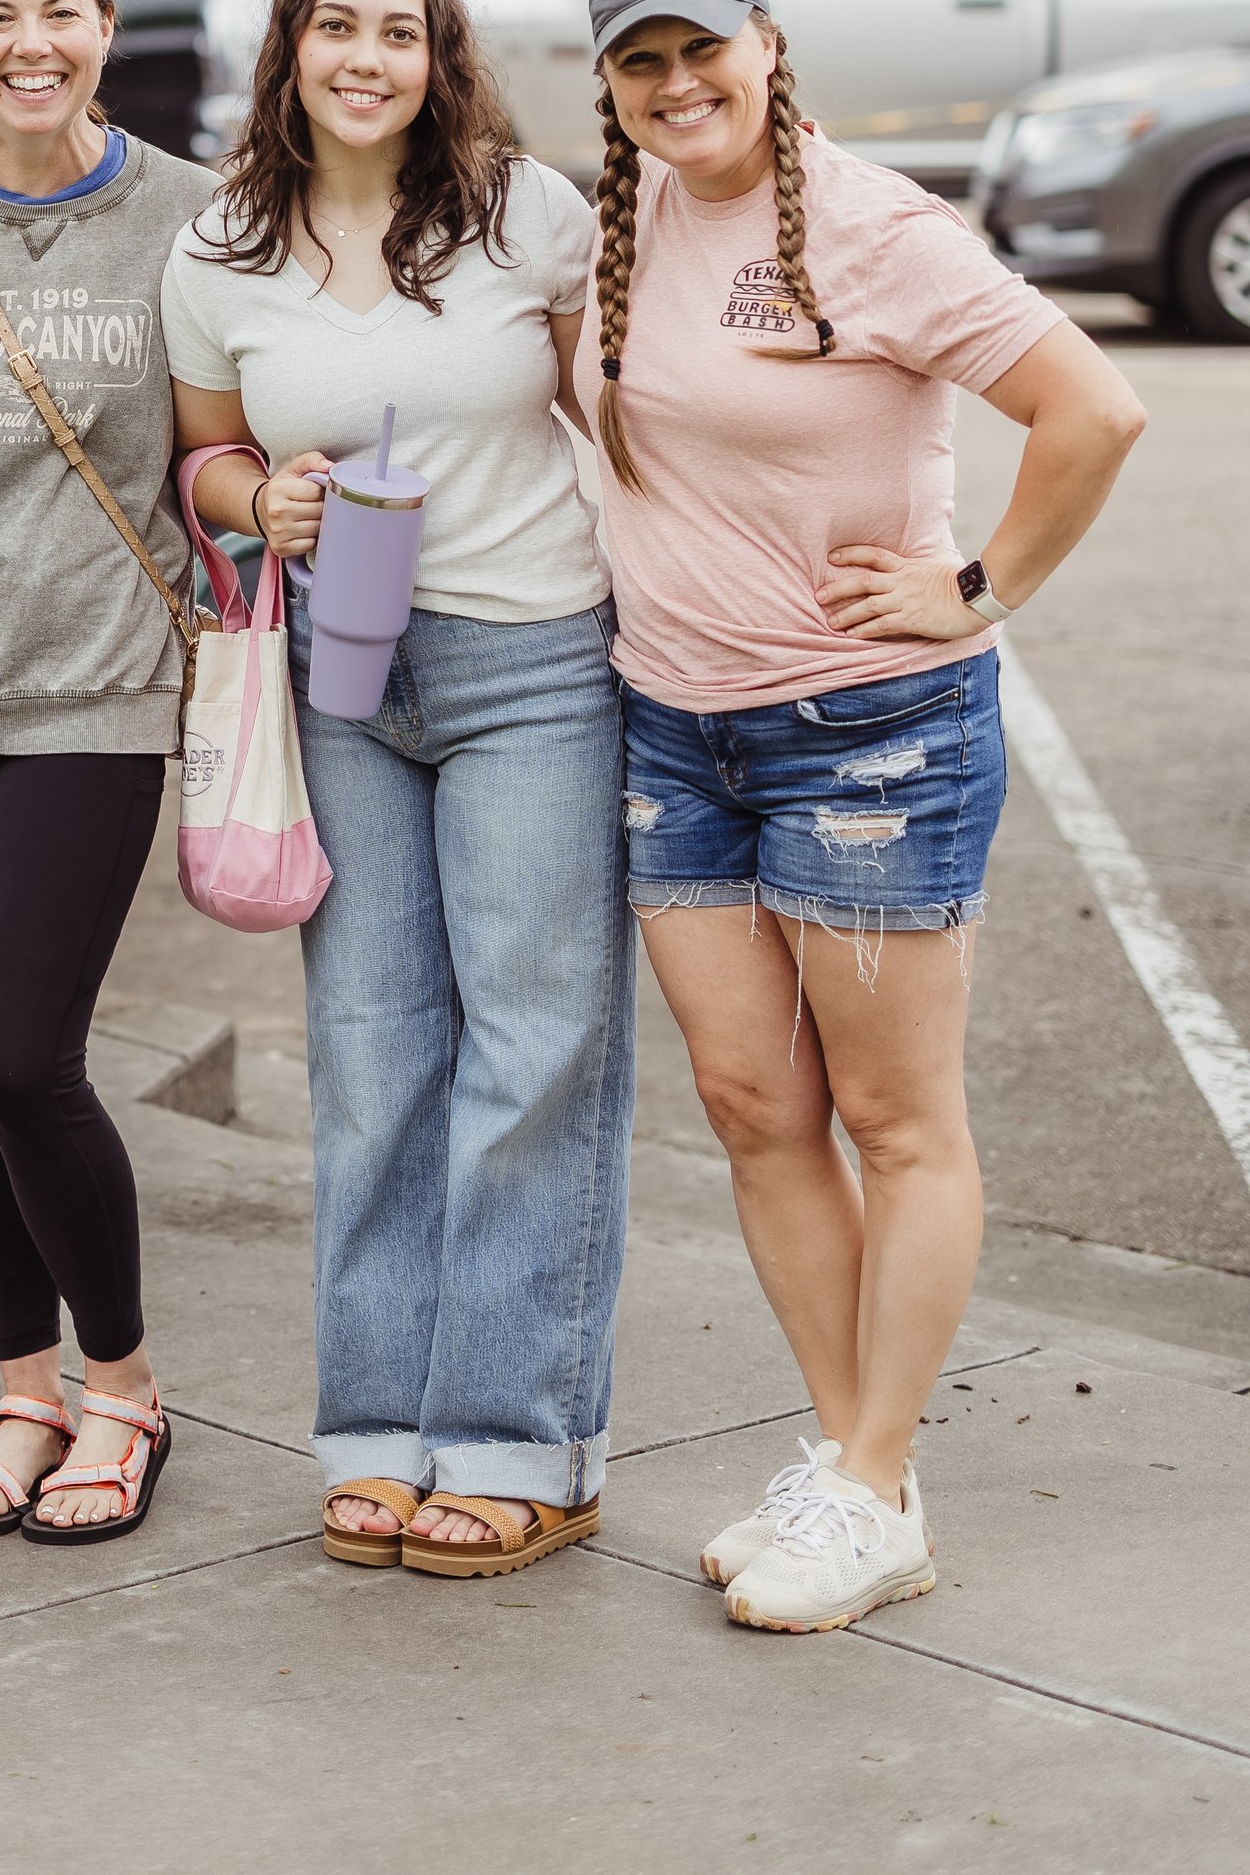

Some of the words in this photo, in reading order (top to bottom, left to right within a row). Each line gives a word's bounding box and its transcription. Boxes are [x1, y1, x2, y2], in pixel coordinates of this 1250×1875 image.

[742, 266, 786, 282] TEXA
[31, 287, 89, 312] 1919
[727, 300, 793, 318] BURGER
[727, 314, 785, 330] BASH
[18, 314, 146, 373] CANYON
[54, 380, 94, 390] RIGHT
[184, 749, 225, 765] DER
[182, 765, 215, 782] OE'S
